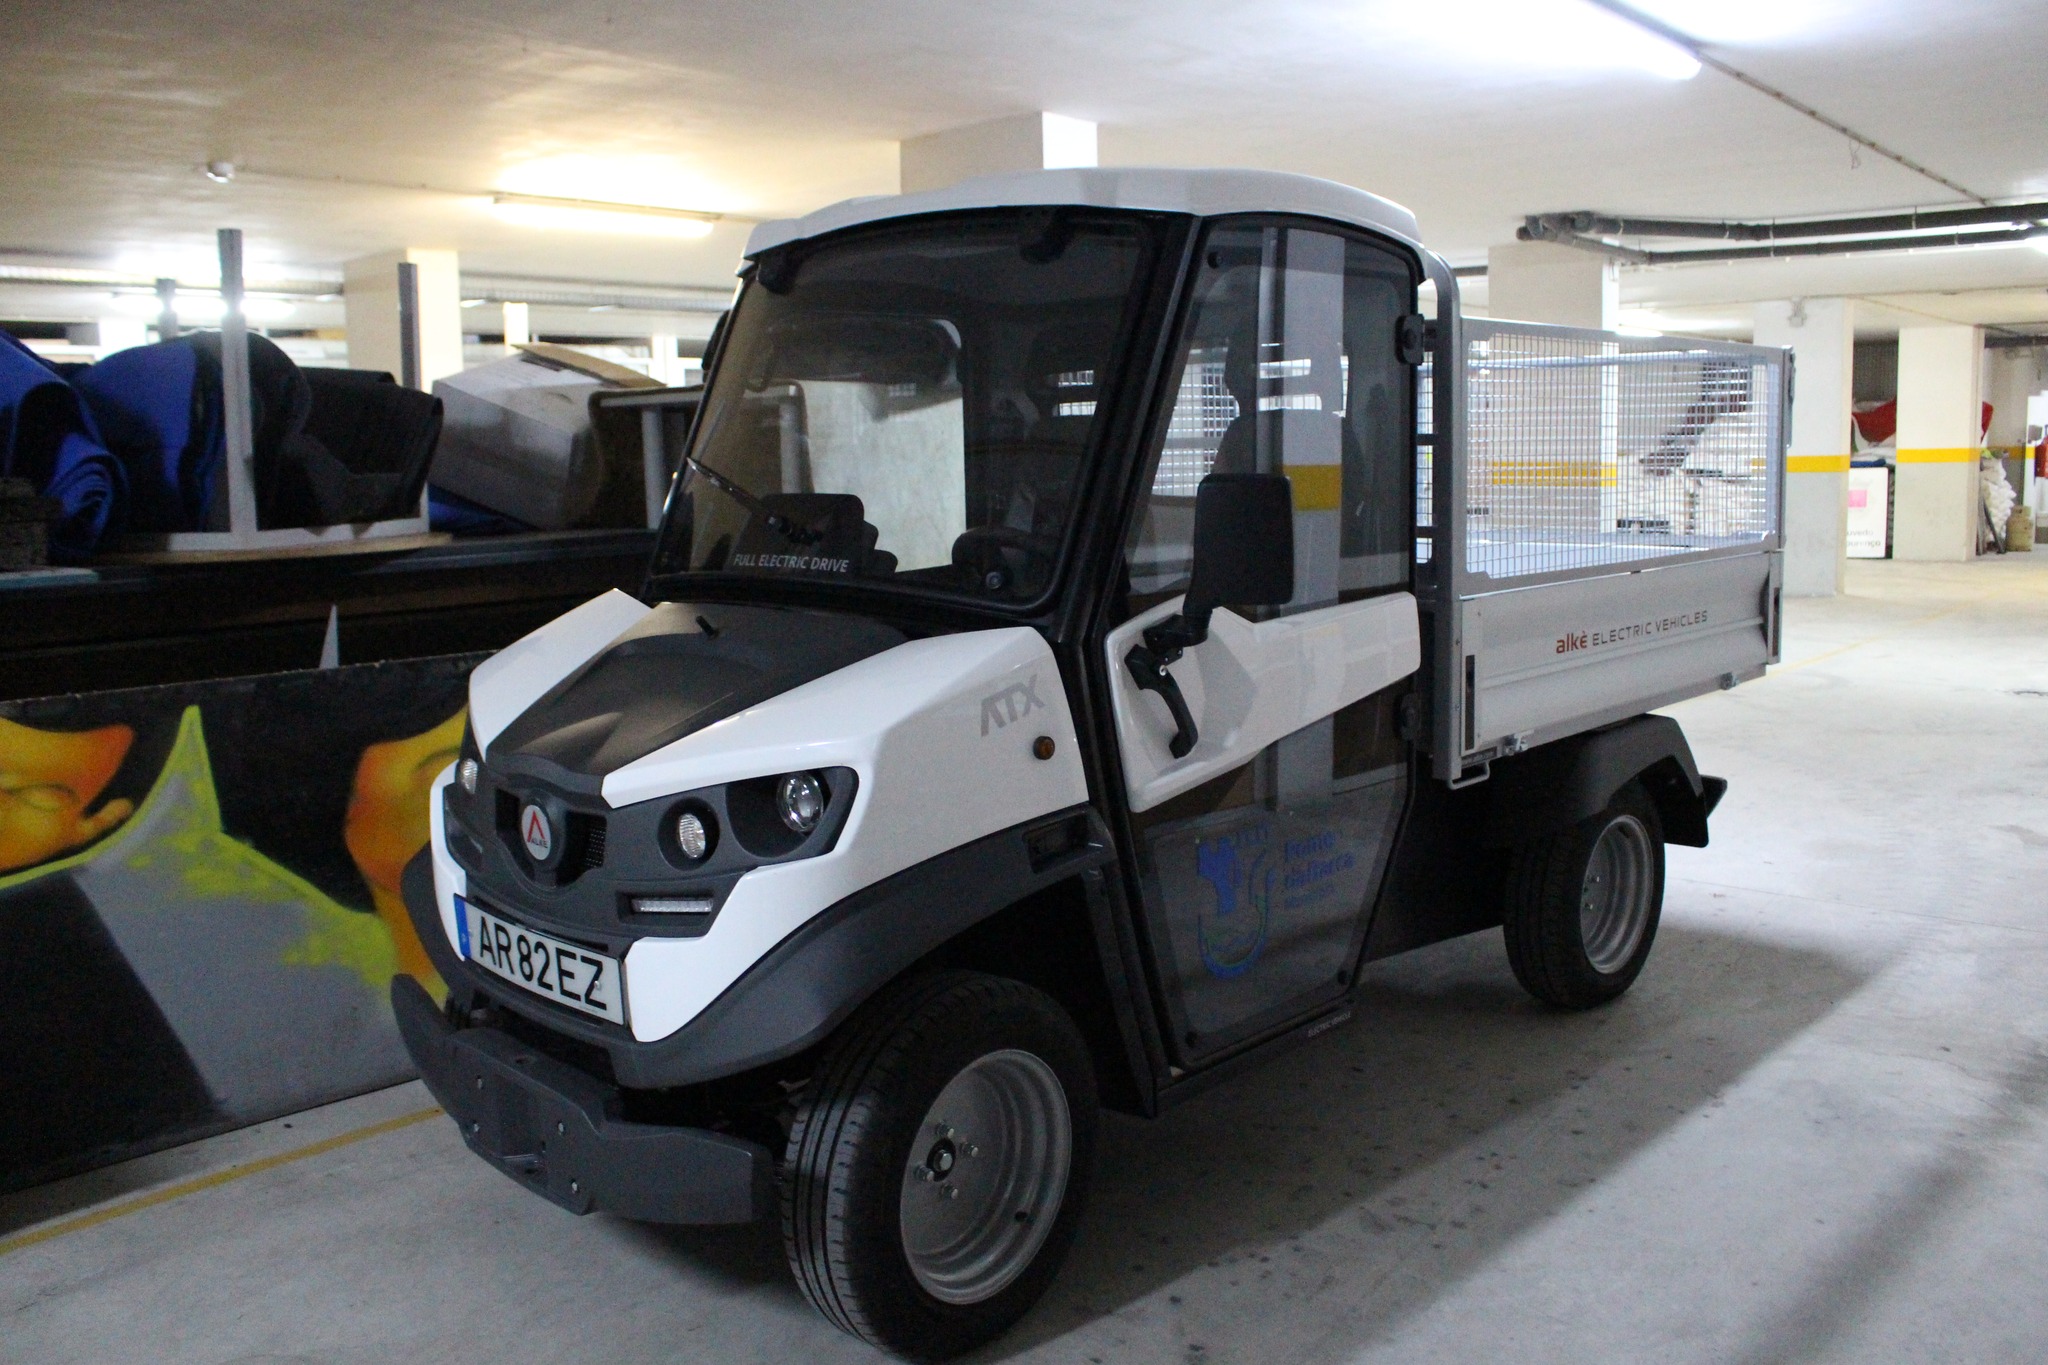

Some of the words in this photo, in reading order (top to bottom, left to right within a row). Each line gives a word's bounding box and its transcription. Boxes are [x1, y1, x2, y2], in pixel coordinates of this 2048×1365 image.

[733, 553, 756, 567] FULL
[758, 554, 806, 570] ELECTRIC
[810, 557, 849, 573] DRIVE
[1592, 622, 1652, 647] ELECTRIC
[1655, 610, 1708, 633] VEHICLES
[981, 673, 1046, 737] ATX
[479, 915, 608, 1012] AR82EZ
